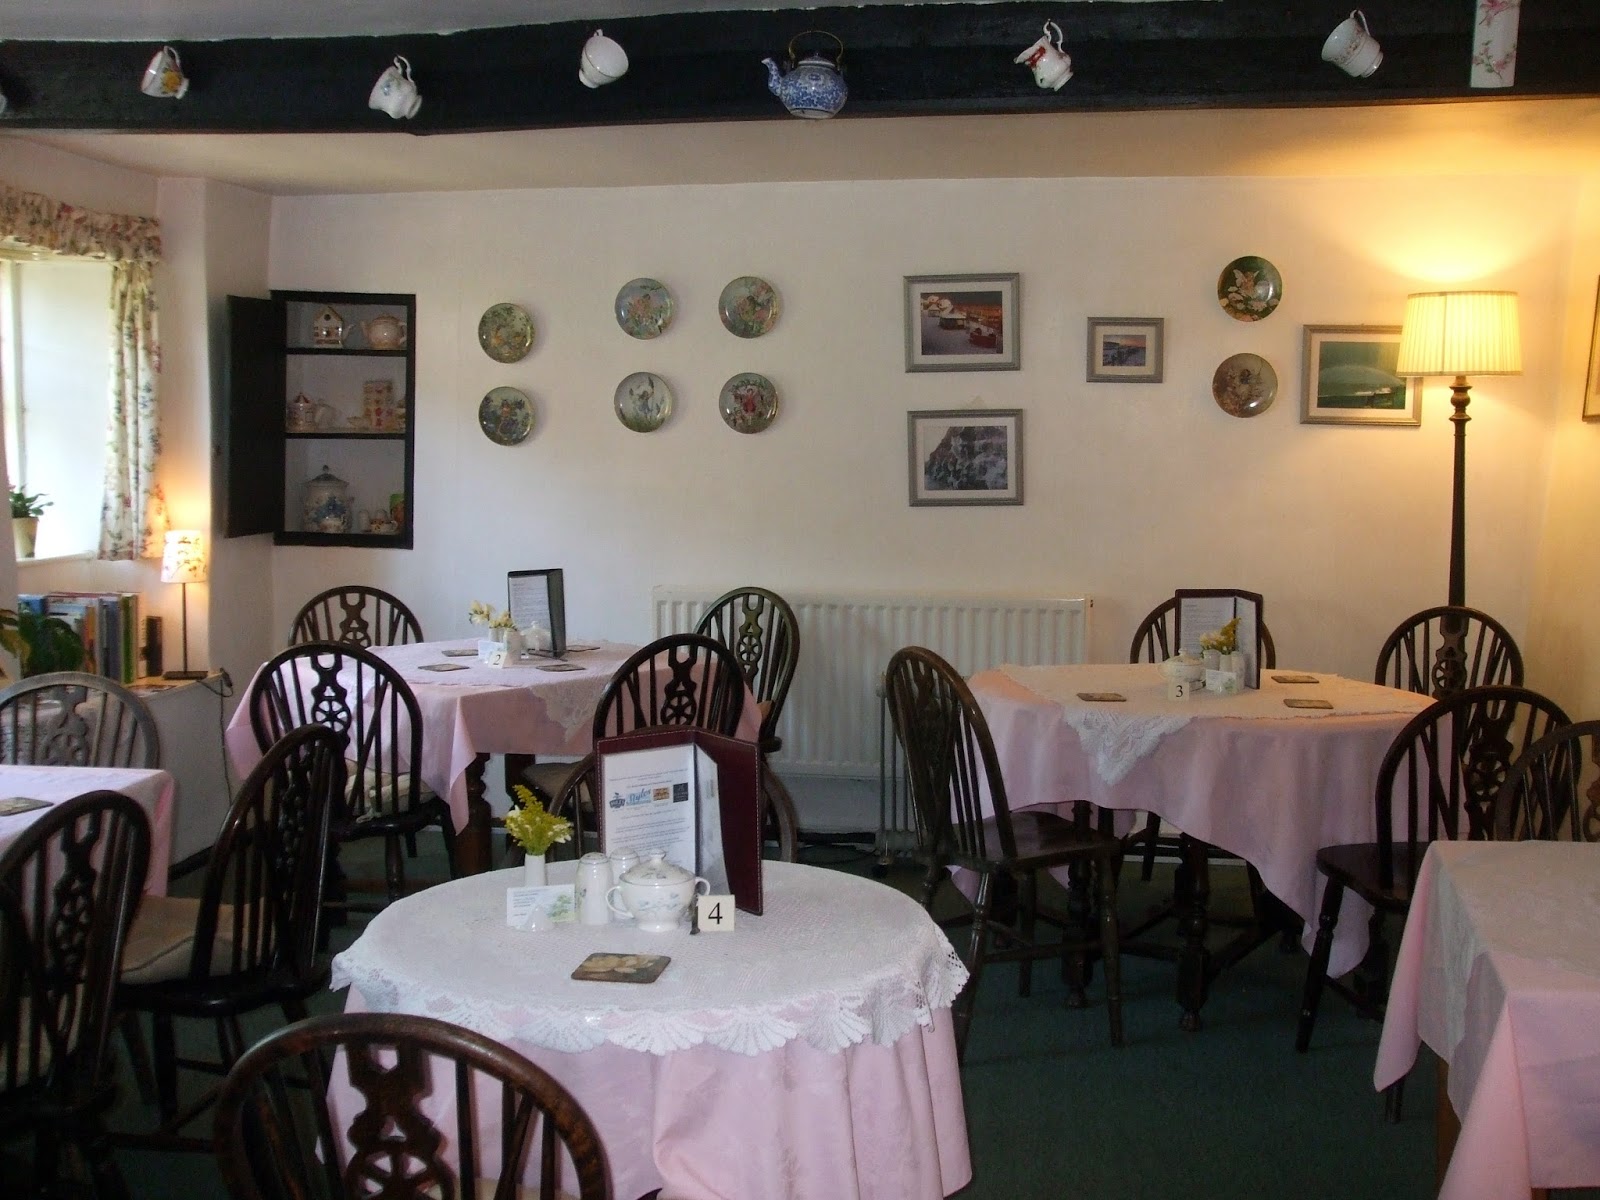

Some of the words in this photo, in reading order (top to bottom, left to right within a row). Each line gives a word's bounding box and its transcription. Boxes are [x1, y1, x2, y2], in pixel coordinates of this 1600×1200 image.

[493, 654, 501, 665] 2
[1175, 685, 1183, 697] 3
[708, 902, 723, 924] 4
